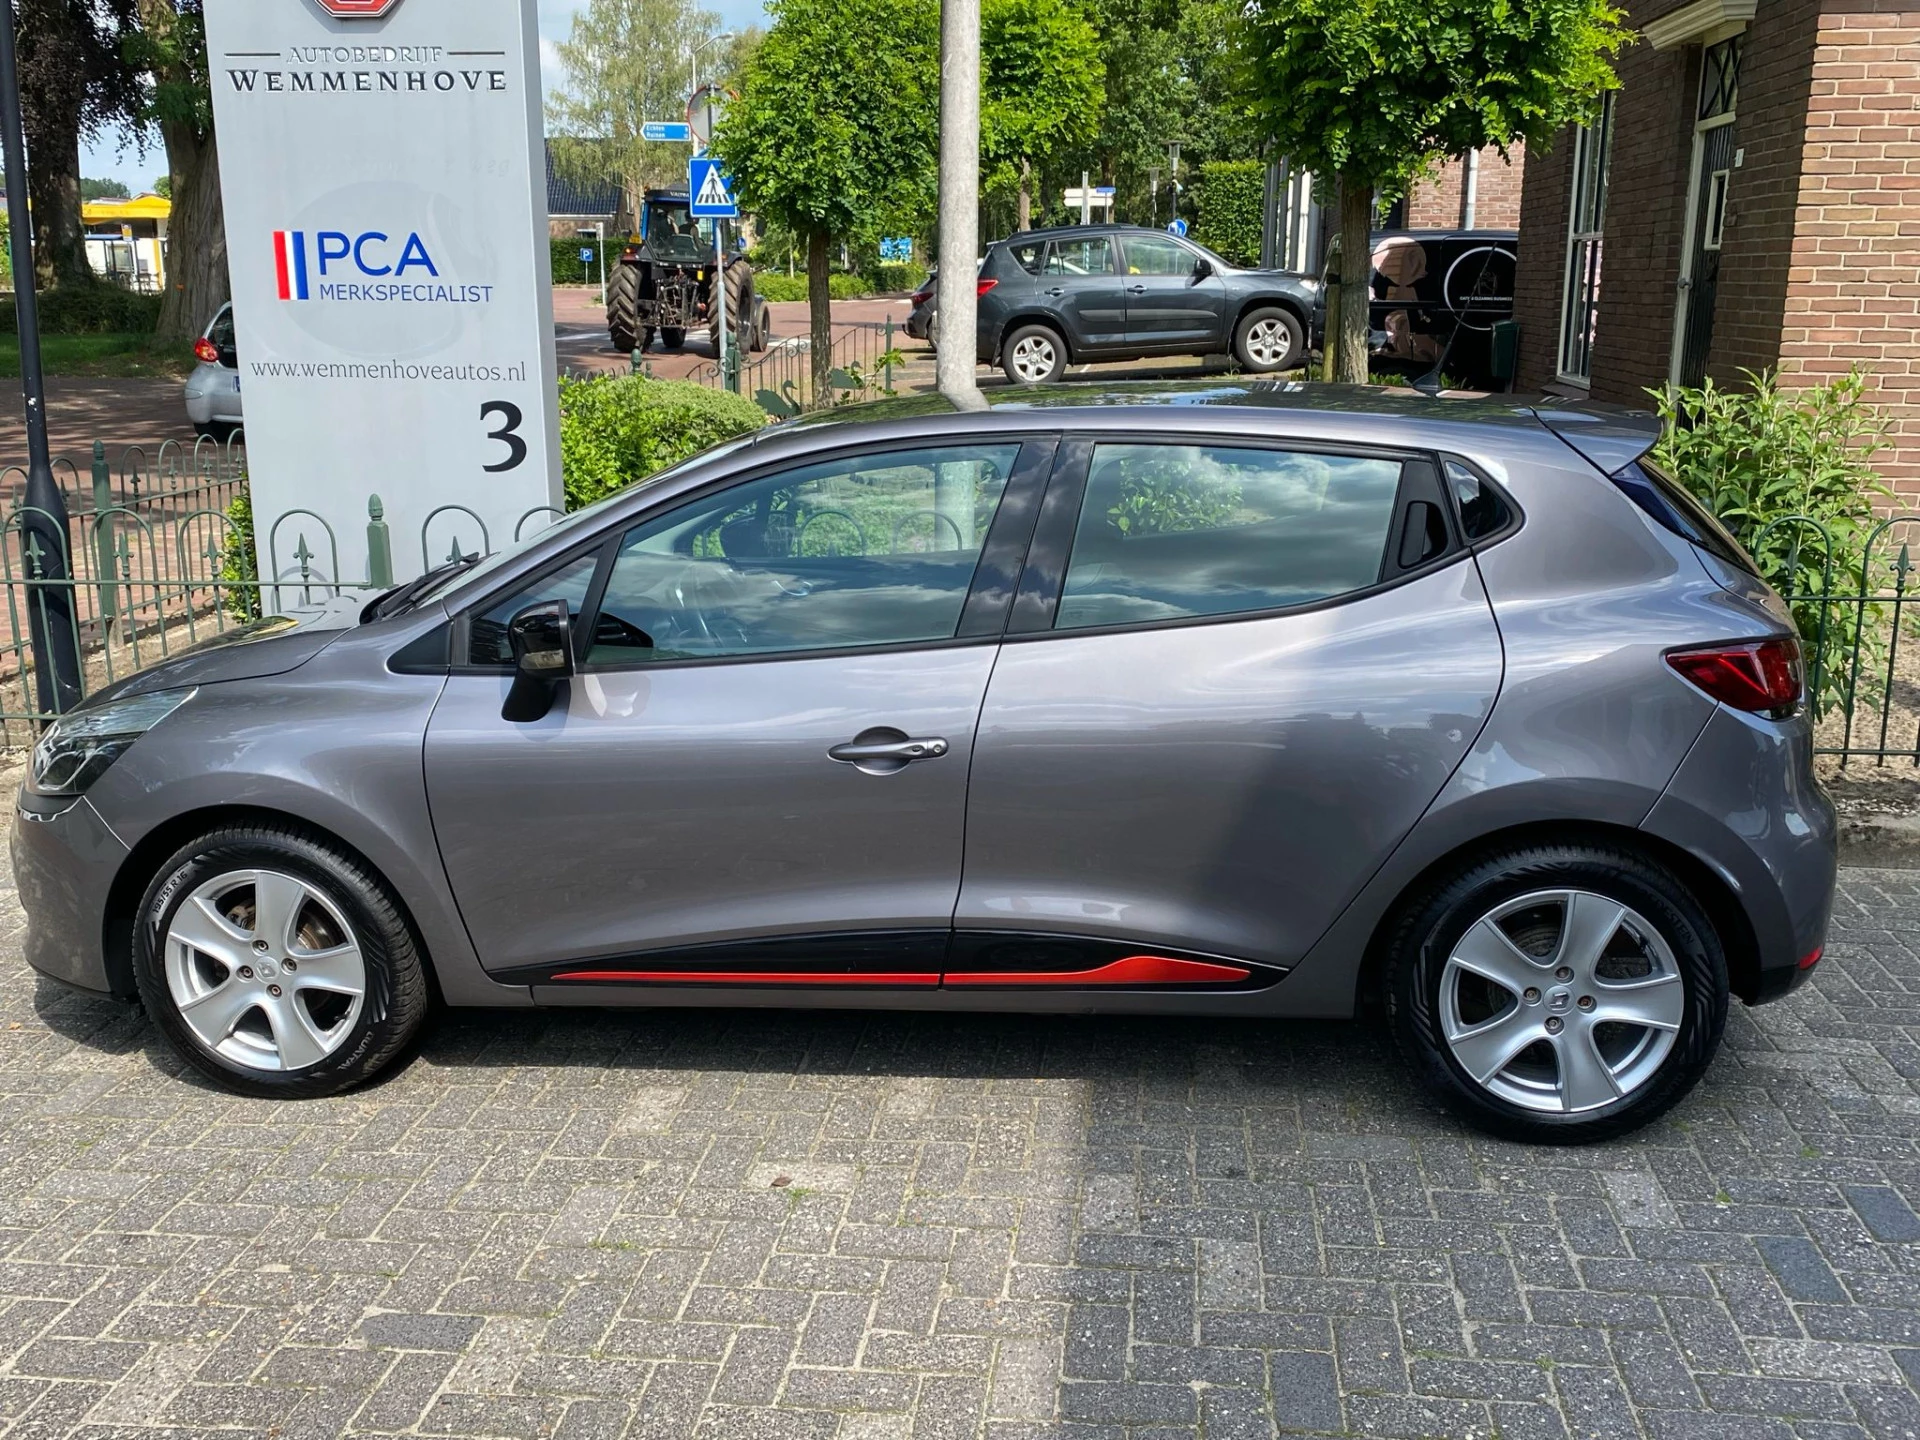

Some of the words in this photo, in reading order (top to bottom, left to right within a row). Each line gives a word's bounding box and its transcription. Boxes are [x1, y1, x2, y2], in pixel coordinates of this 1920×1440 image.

[286, 47, 443, 64] AUTOBEDRIJF
[226, 69, 507, 92] WEMMENHOVE
[316, 231, 440, 277] PCA
[583, 250, 590, 260] P
[319, 284, 494, 303] MERKSPECIALIST
[251, 359, 527, 382] www.wemmenhoveautos.nl
[479, 400, 528, 473] 3
[152, 886, 173, 914] 195/55
[170, 879, 179, 889] R
[177, 871, 188, 882] 16
